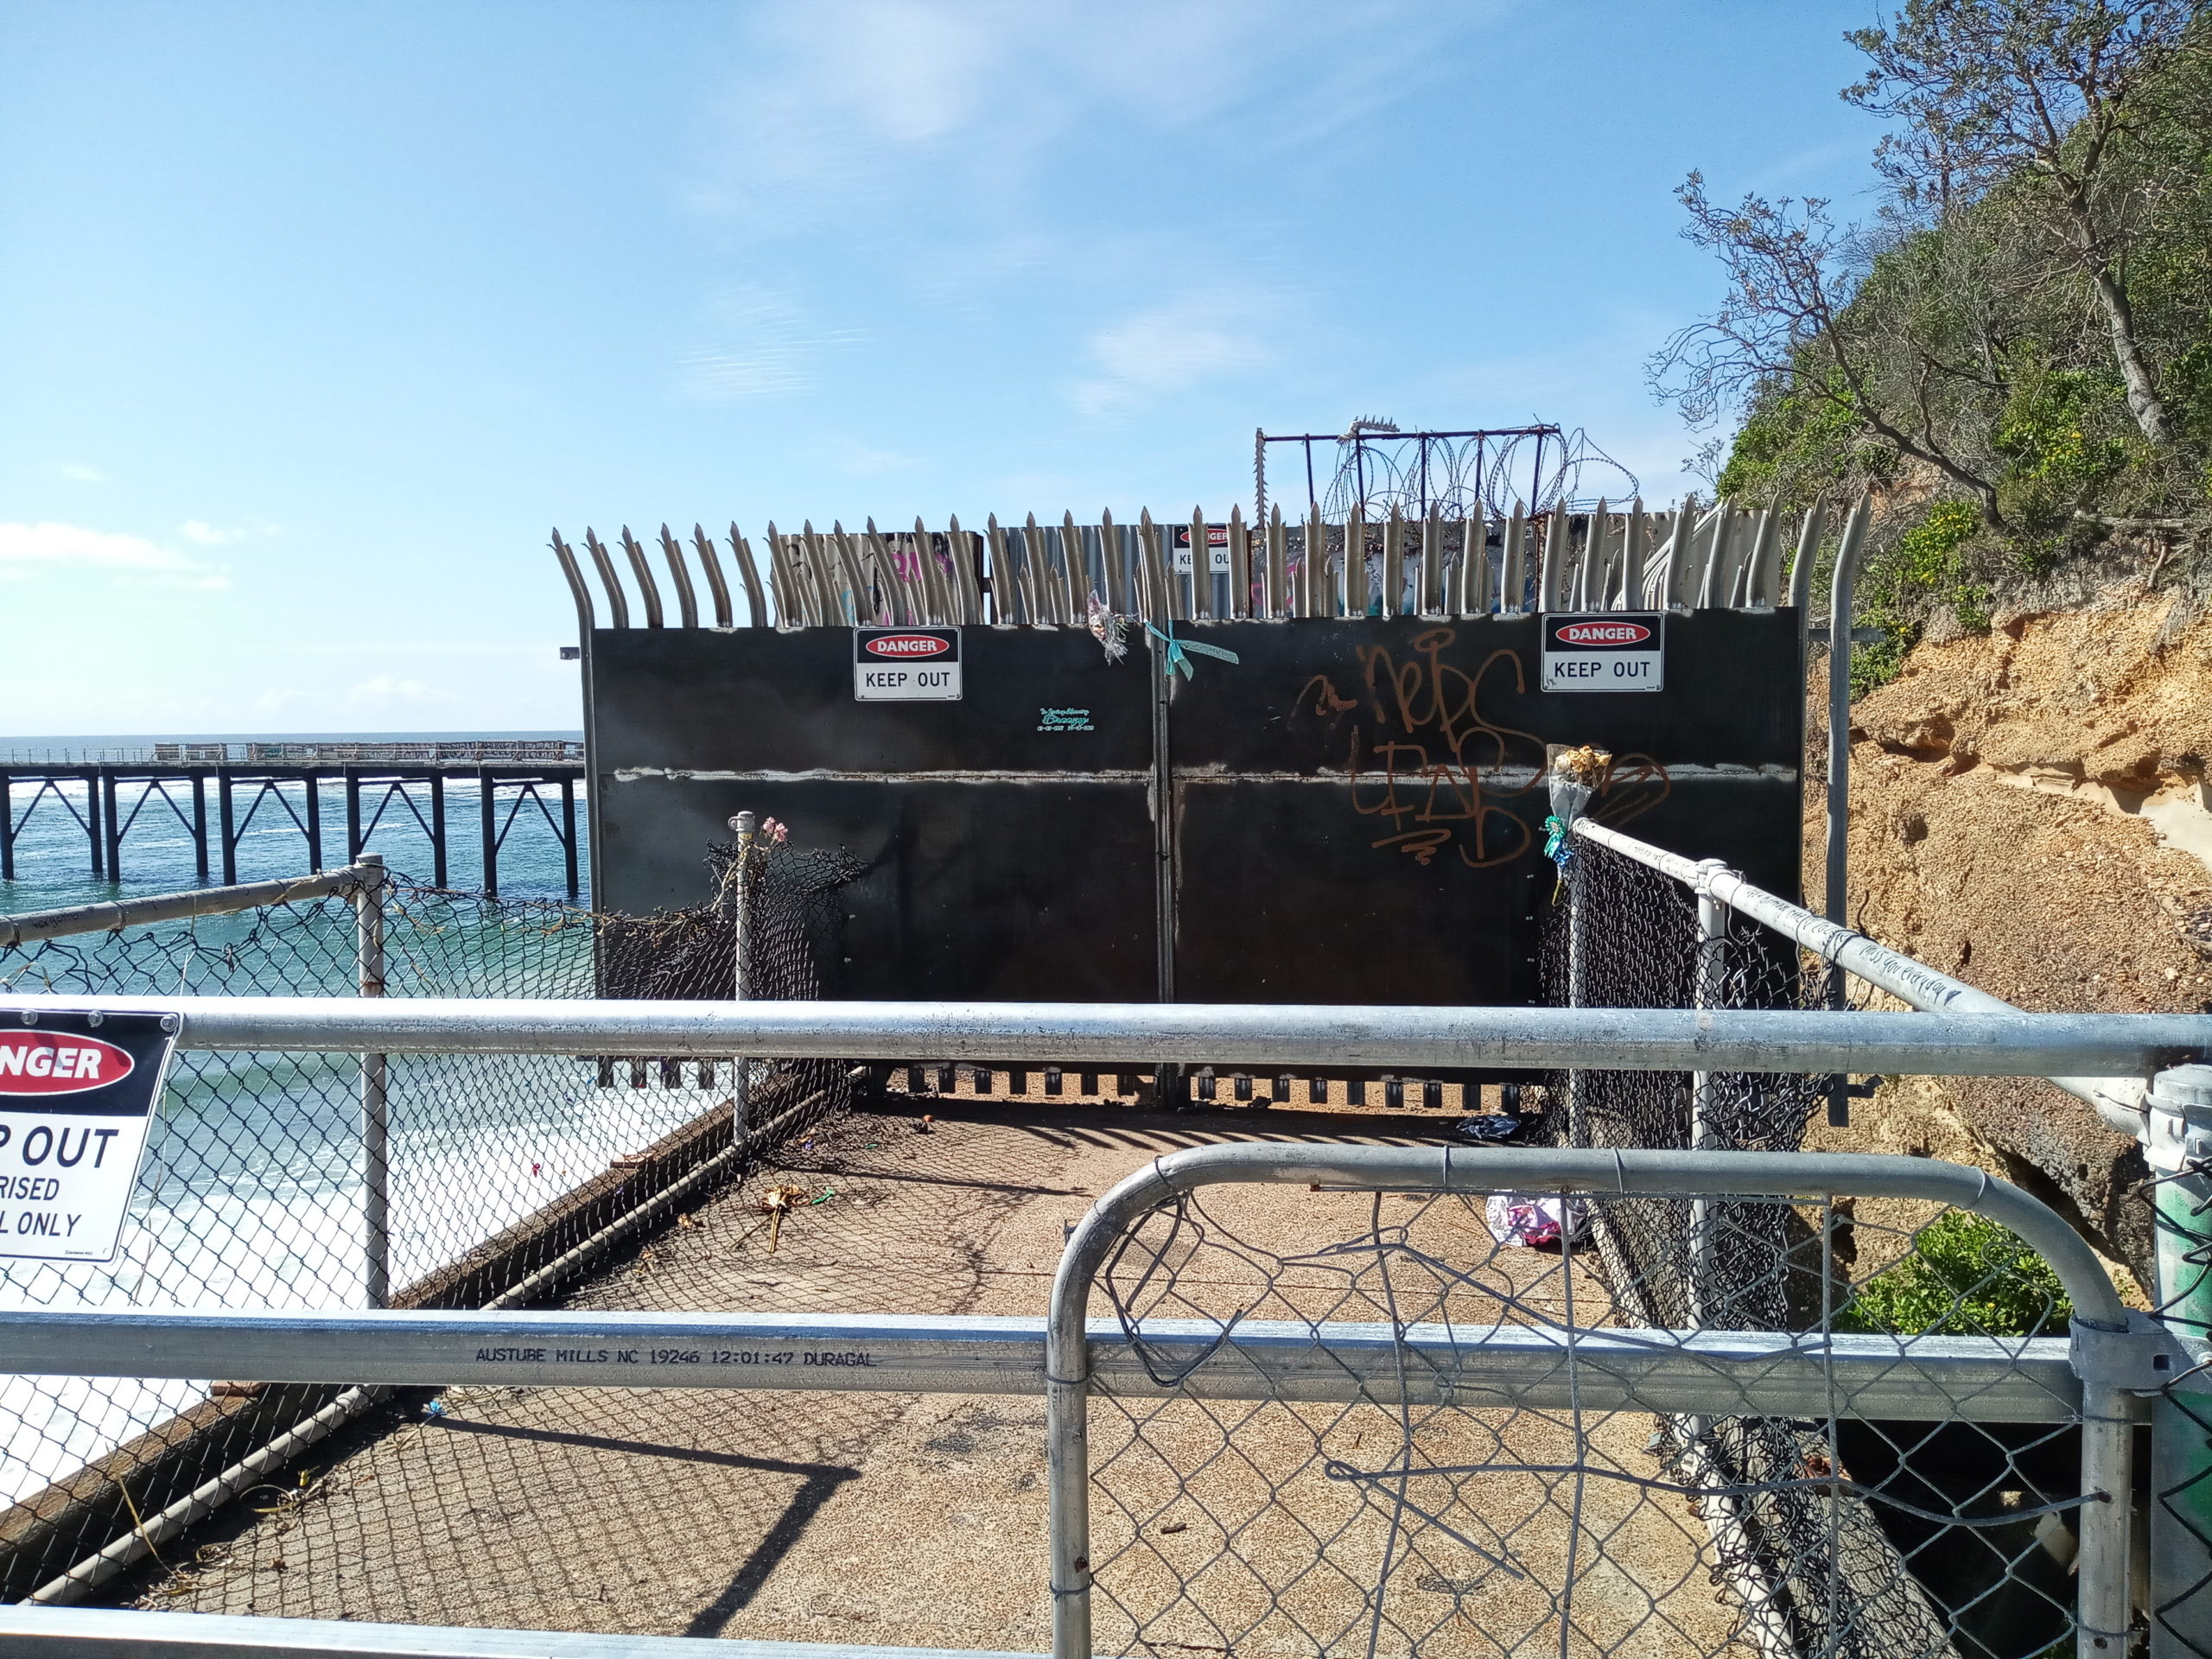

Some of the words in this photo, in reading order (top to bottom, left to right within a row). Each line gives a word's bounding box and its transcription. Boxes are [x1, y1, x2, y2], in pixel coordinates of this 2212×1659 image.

[1179, 554, 1192, 565] KE
[1215, 553, 1230, 564] OU
[1568, 627, 1637, 640] DANGER
[877, 640, 938, 652] DANGER
[866, 672, 908, 687] KEEP
[918, 671, 950, 687] OUT
[1554, 662, 1602, 677] KEEP
[1613, 661, 1650, 677] OUT
[1882, 957, 1903, 976] you
[1901, 966, 1947, 1004] everyday
[0, 1045, 102, 1079] NGER
[22, 1125, 119, 1168] OUT
[0, 1175, 60, 1201] RISED
[17, 1211, 82, 1237] ONLY
[475, 1347, 547, 1363] AUSTUBE
[556, 1349, 608, 1363] MILLS
[617, 1349, 639, 1363] NC
[650, 1349, 700, 1364] 19246
[711, 1350, 794, 1365] 12:01:47
[804, 1351, 877, 1367] DURAGAL
